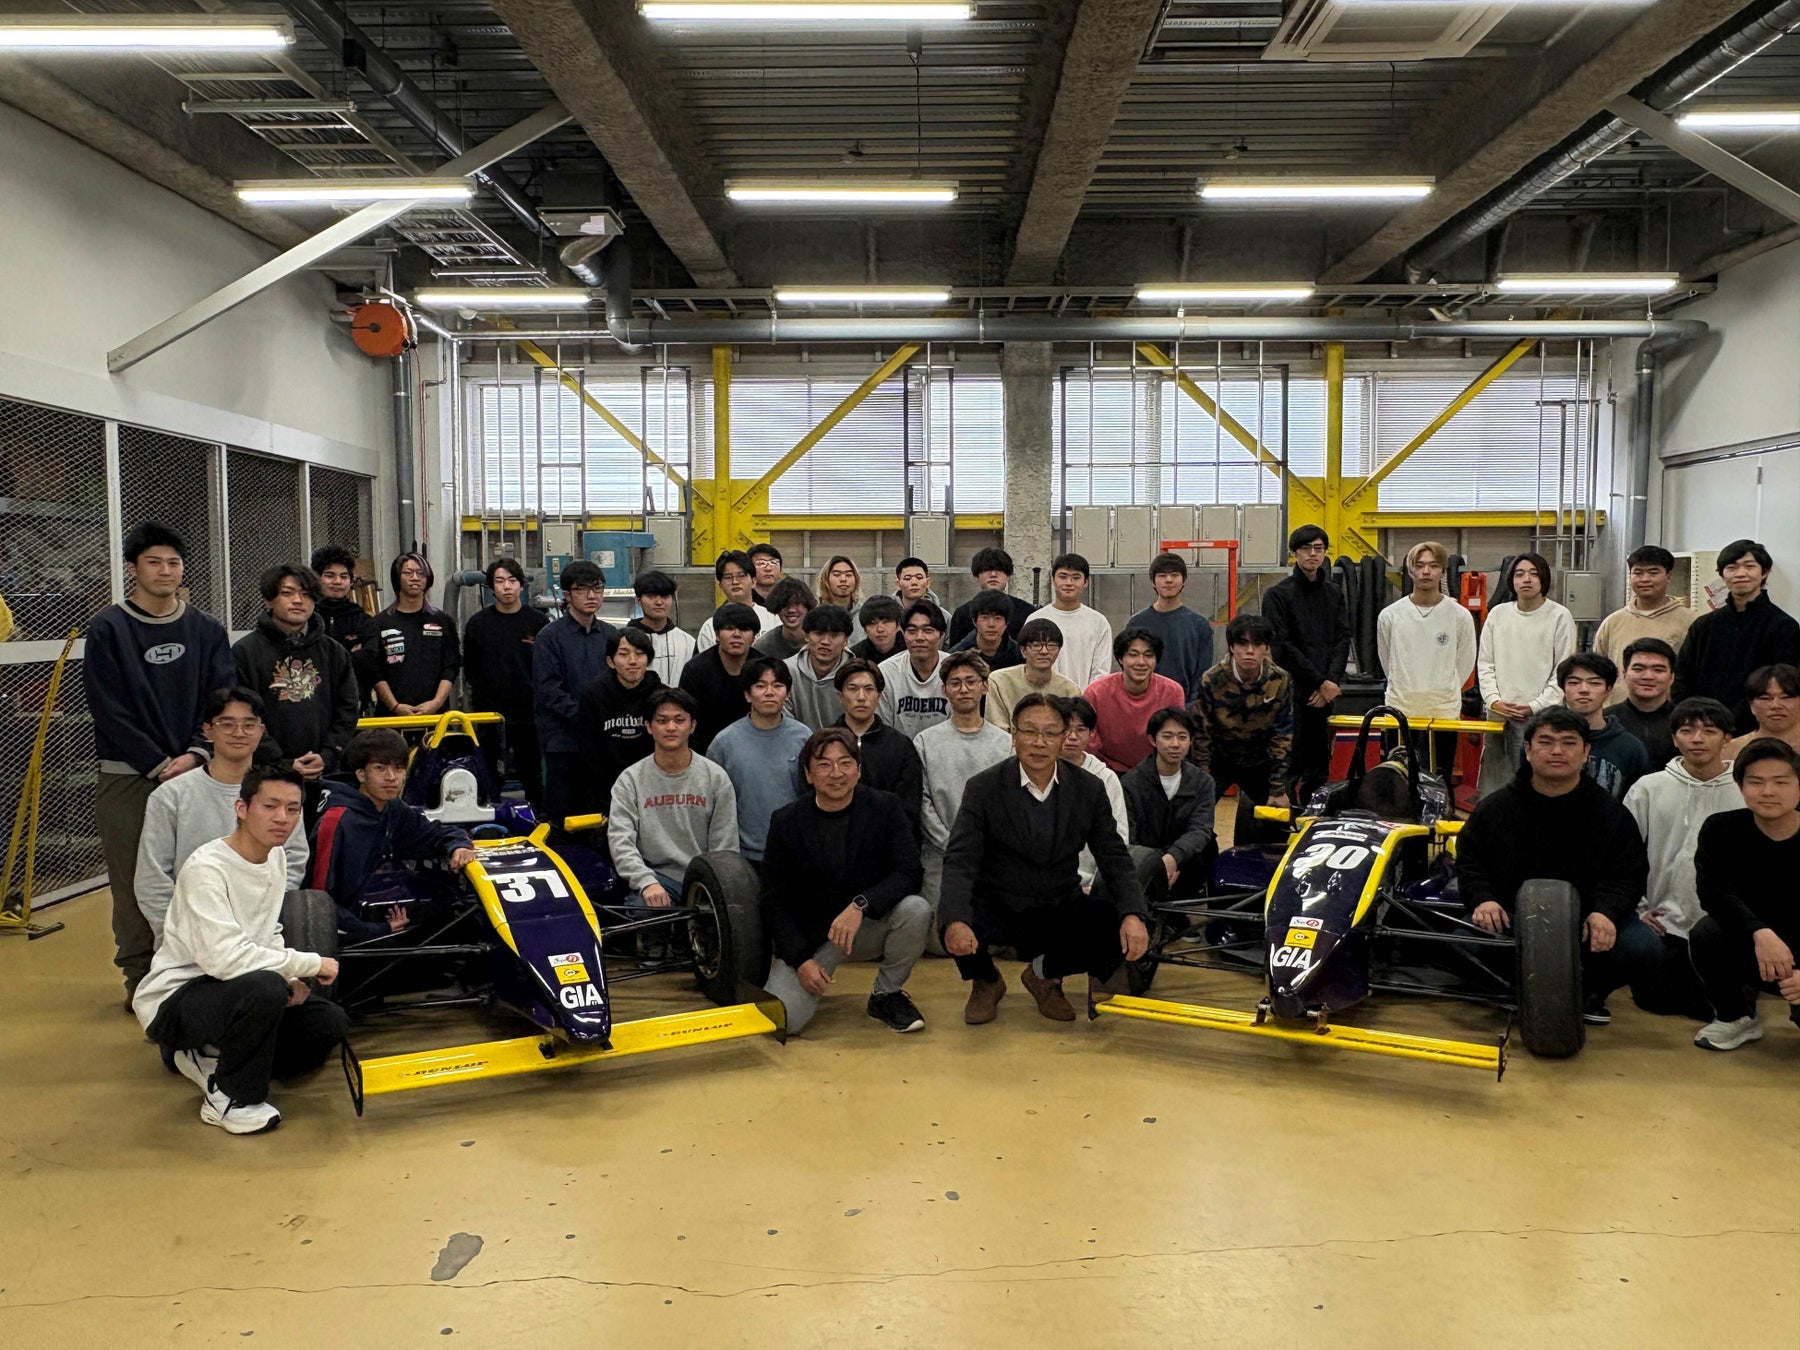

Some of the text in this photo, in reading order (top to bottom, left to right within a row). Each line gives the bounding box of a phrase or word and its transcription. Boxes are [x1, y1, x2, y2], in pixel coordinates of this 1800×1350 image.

[643, 793, 706, 809] AUBURN
[488, 869, 569, 903] 31
[1272, 946, 1312, 969] GIA
[560, 983, 604, 1009] GIA
